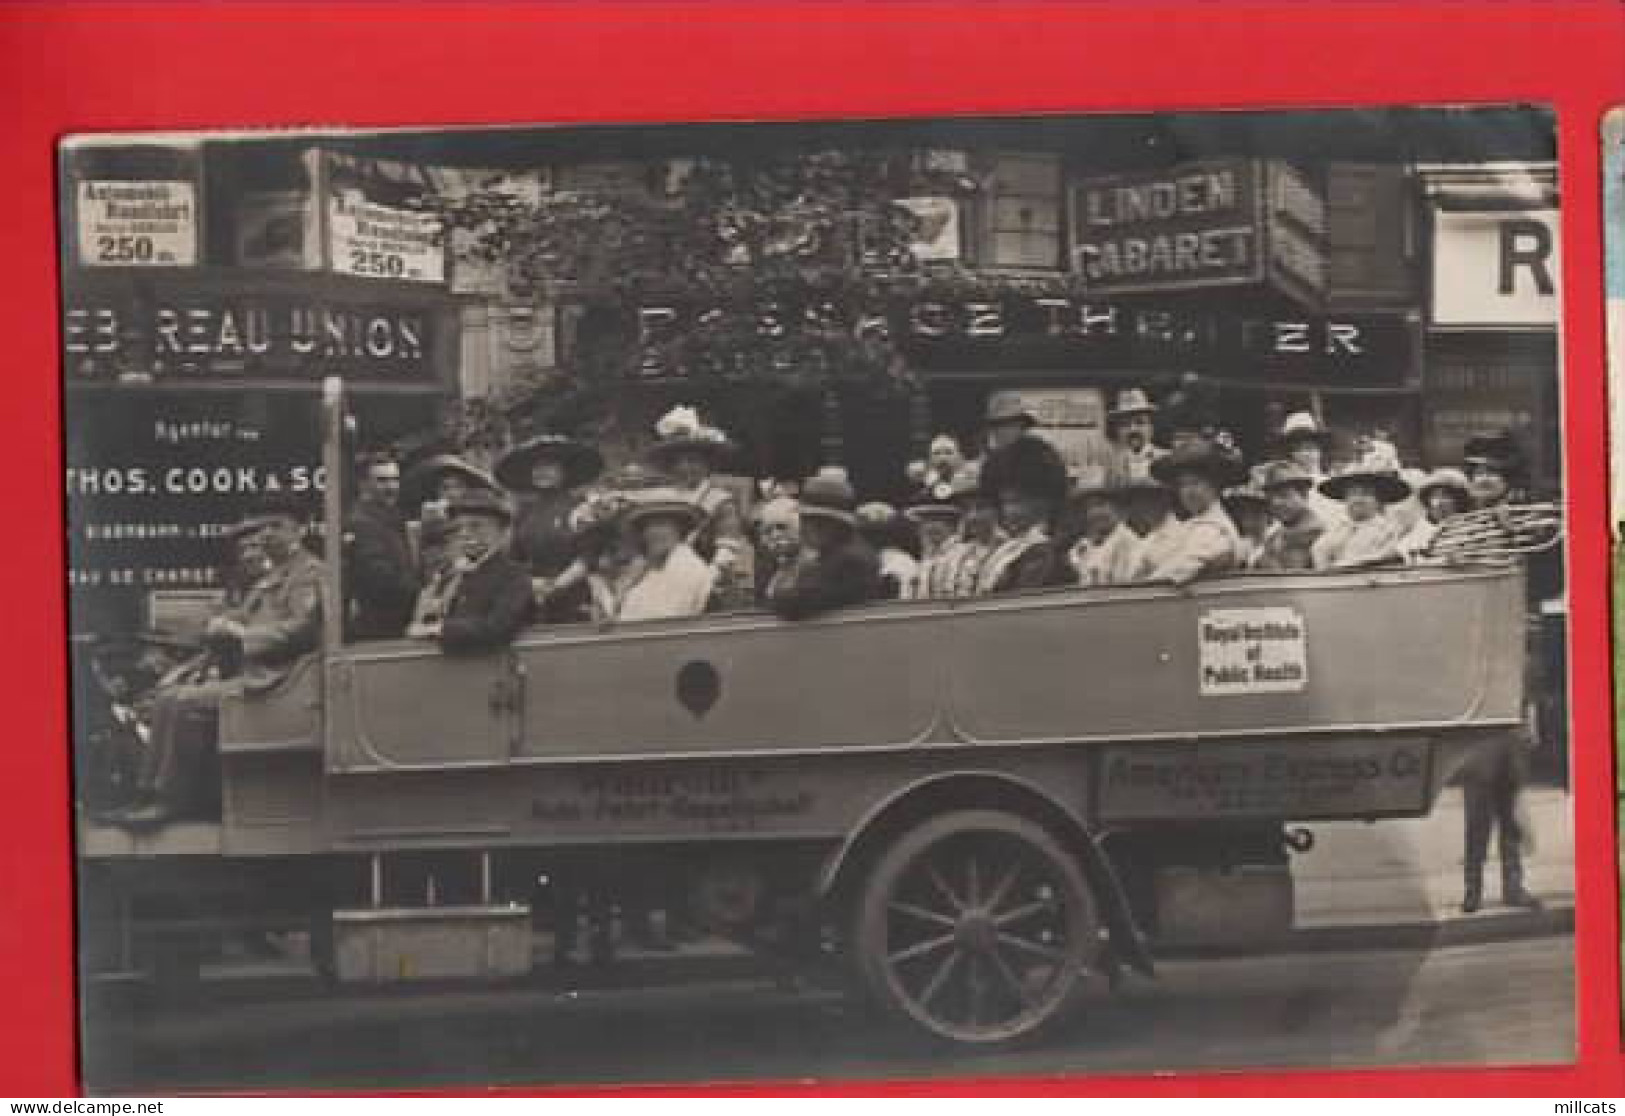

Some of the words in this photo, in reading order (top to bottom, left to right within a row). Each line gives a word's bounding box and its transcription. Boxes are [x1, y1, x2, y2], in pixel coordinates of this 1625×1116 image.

[1086, 171, 1236, 224] LINDEN
[97, 235, 154, 261] 250
[351, 250, 405, 275] 250
[1070, 226, 1253, 279] CABARET
[1497, 219, 1555, 297] R
[290, 310, 422, 357] UNION
[165, 467, 258, 493] COOK
[1204, 664, 1249, 687] Public
[1254, 663, 1301, 682] Health
